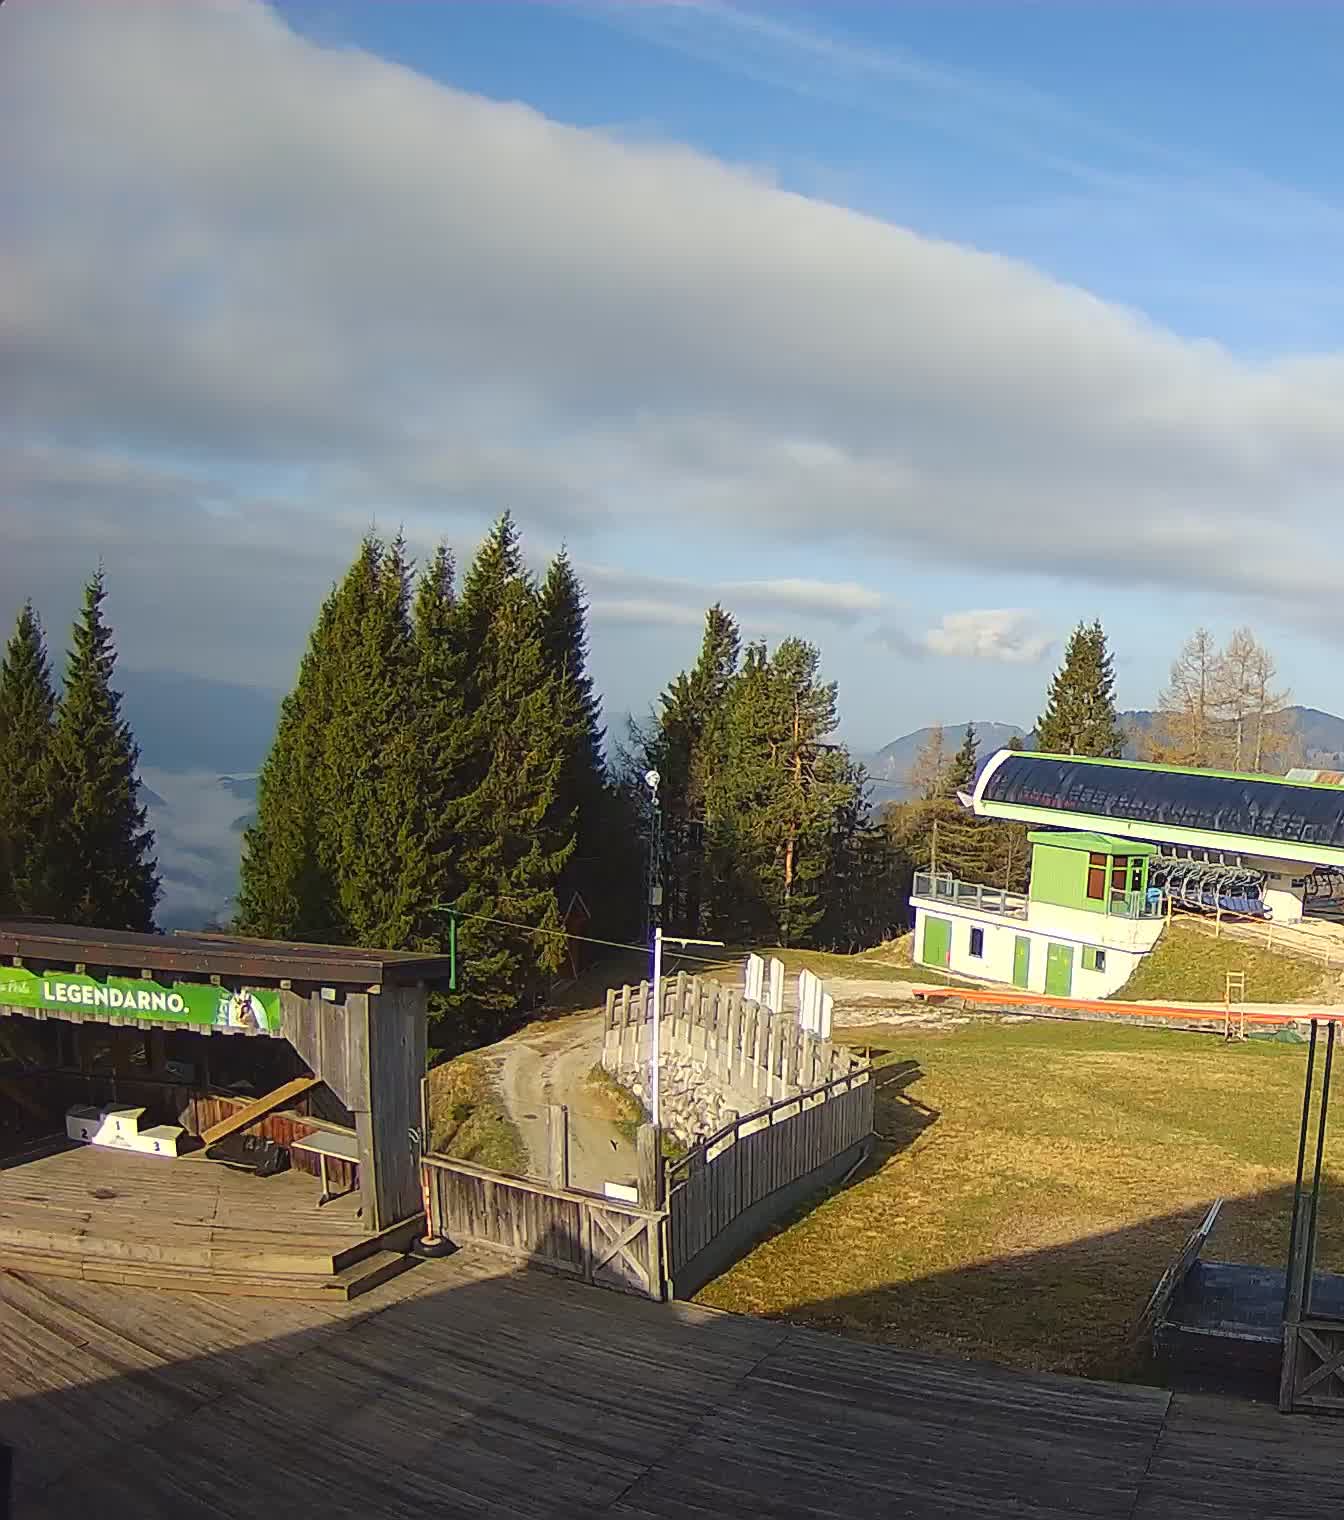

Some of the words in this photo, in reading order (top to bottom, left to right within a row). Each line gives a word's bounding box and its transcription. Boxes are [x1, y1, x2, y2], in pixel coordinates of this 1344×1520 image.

[43, 981, 190, 1014] LEGENDARNO.
[80, 1128, 89, 1140] 2
[152, 1141, 161, 1152] 3
